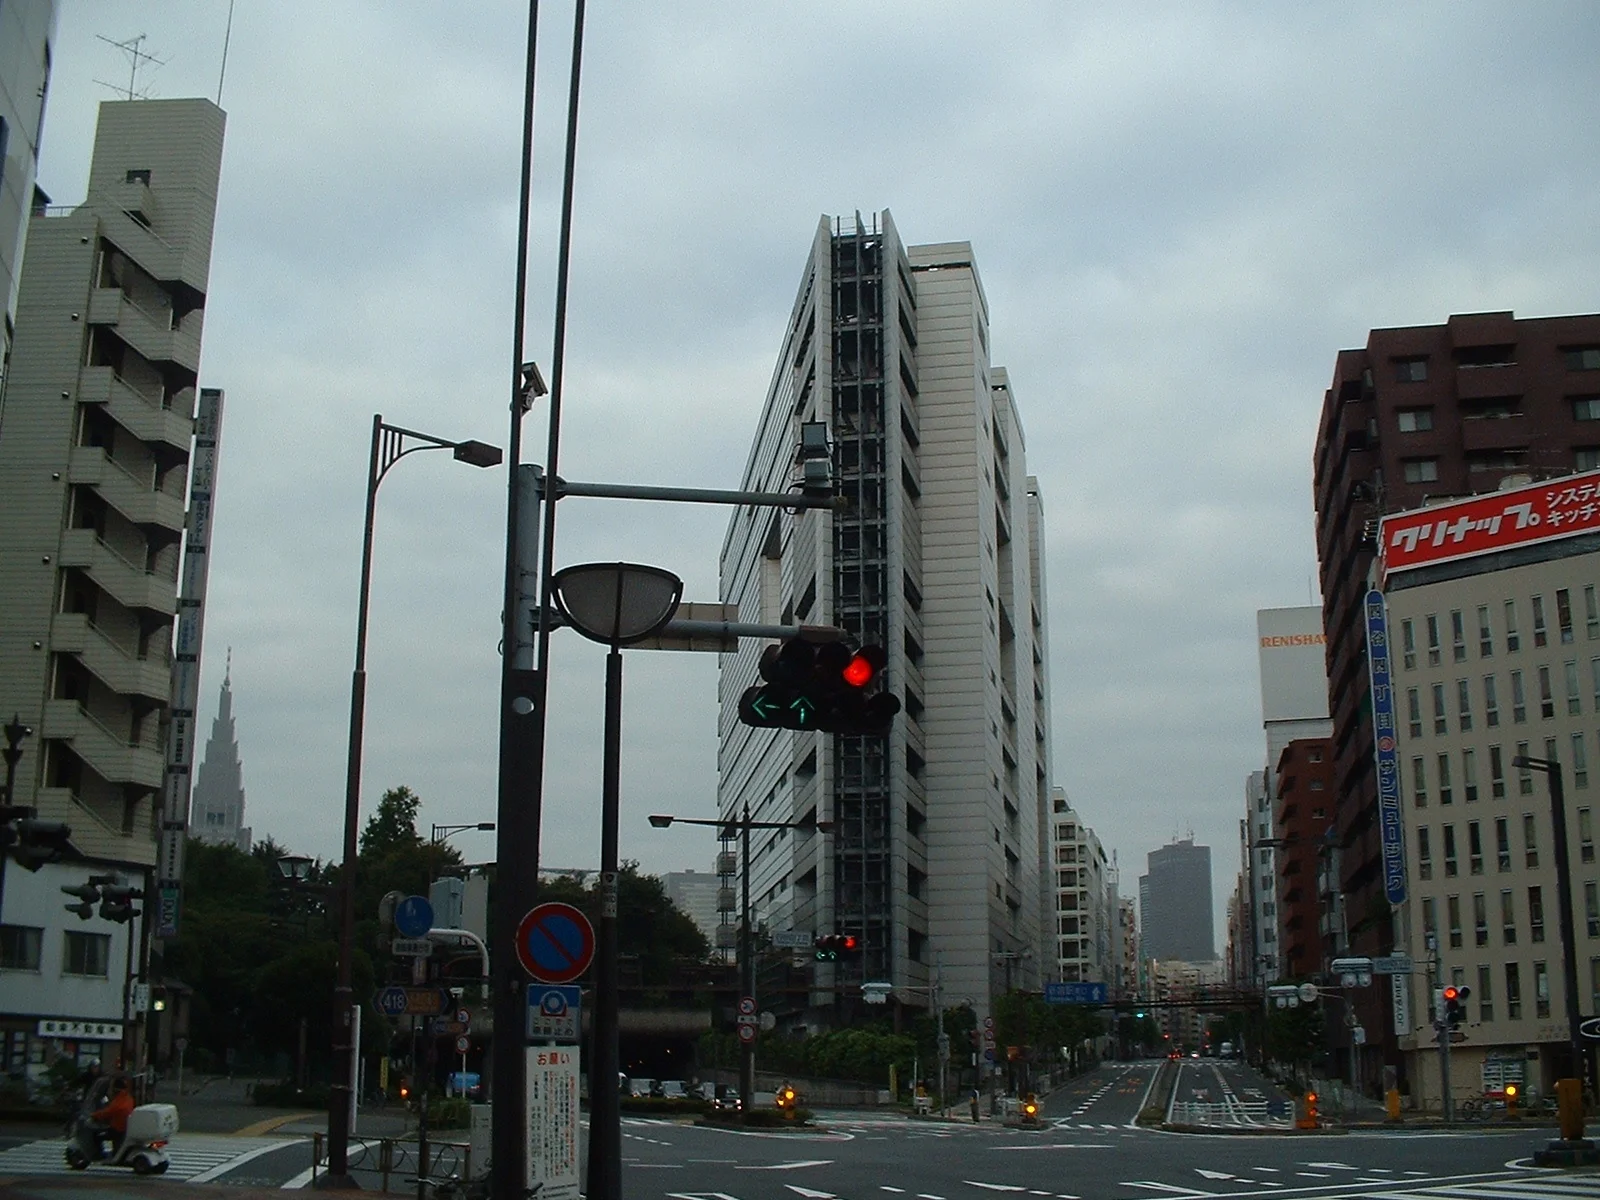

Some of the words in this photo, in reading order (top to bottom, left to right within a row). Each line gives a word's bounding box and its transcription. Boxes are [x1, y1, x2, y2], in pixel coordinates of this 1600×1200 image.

[1546, 502, 1600, 527] キッチ
[1391, 503, 1541, 553] クリナップ
[384, 994, 405, 1010] 418
